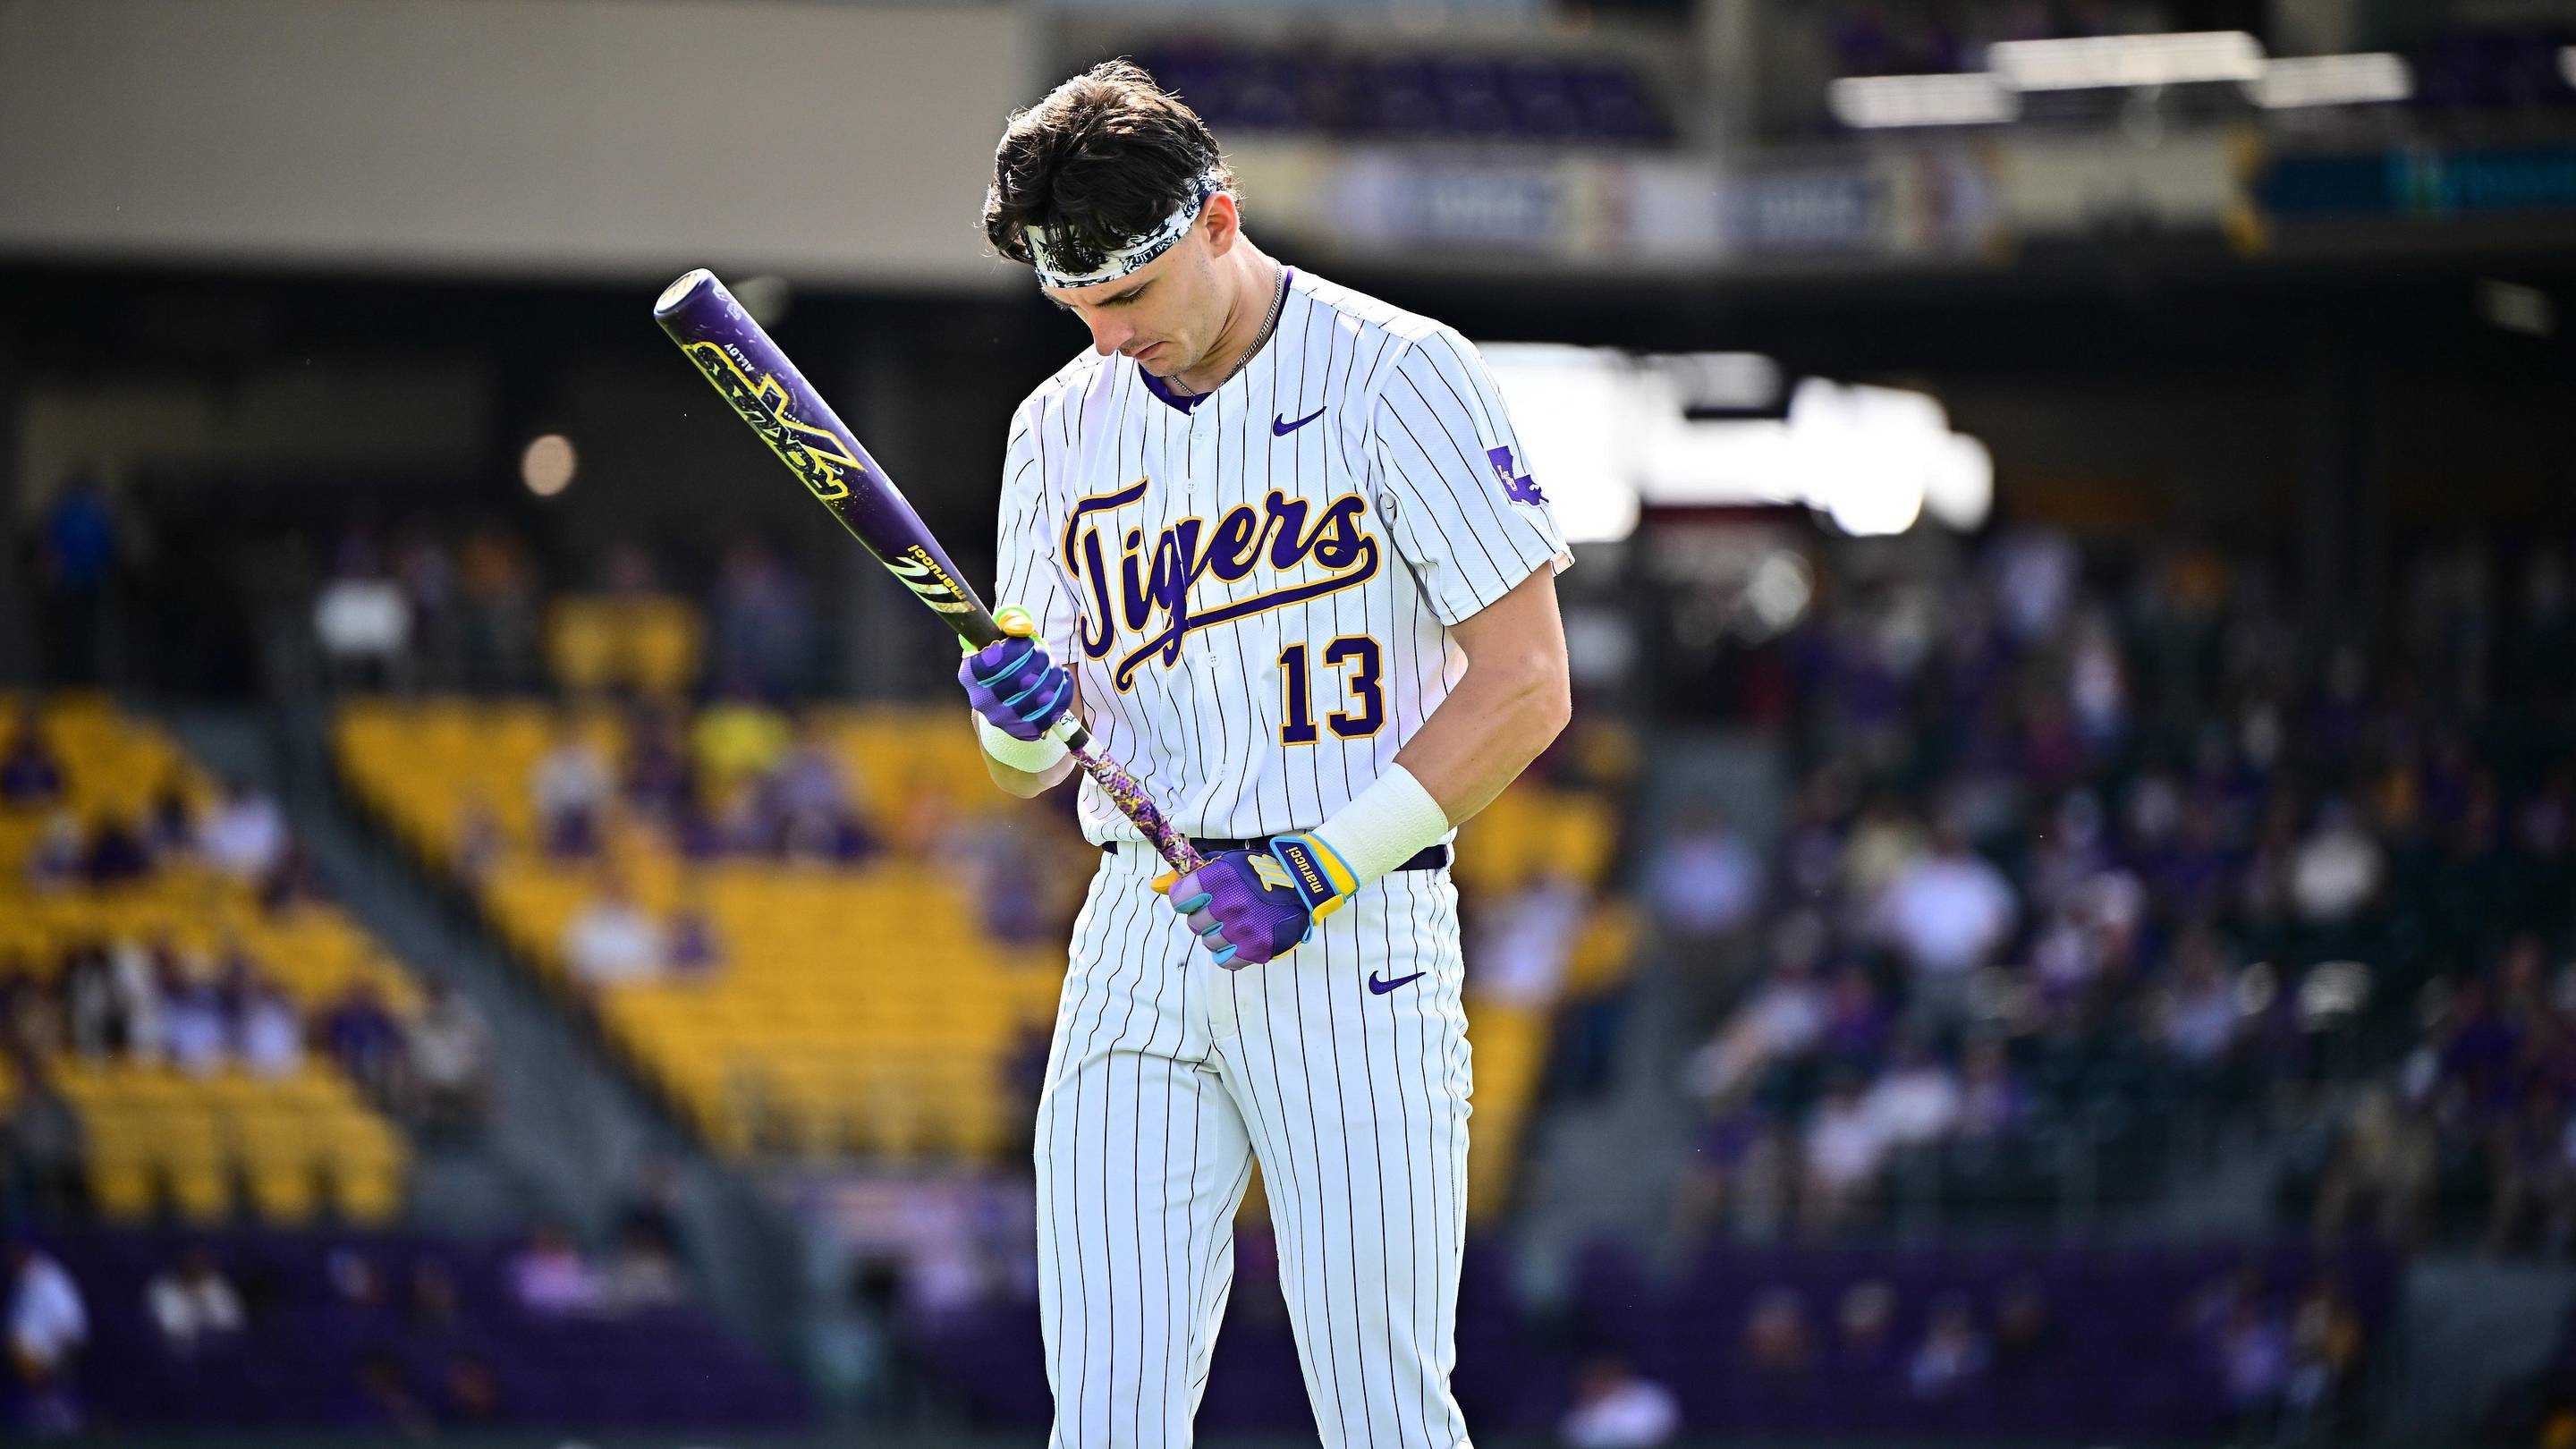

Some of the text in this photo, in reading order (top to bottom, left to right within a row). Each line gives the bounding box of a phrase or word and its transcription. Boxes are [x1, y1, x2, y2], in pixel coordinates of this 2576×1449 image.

[724, 343, 755, 372] ALLOY
[907, 544, 967, 601] marucci
[1062, 476, 1381, 694] Tigers
[1277, 633, 1387, 747] 13
[1284, 846, 1325, 894] marucci
